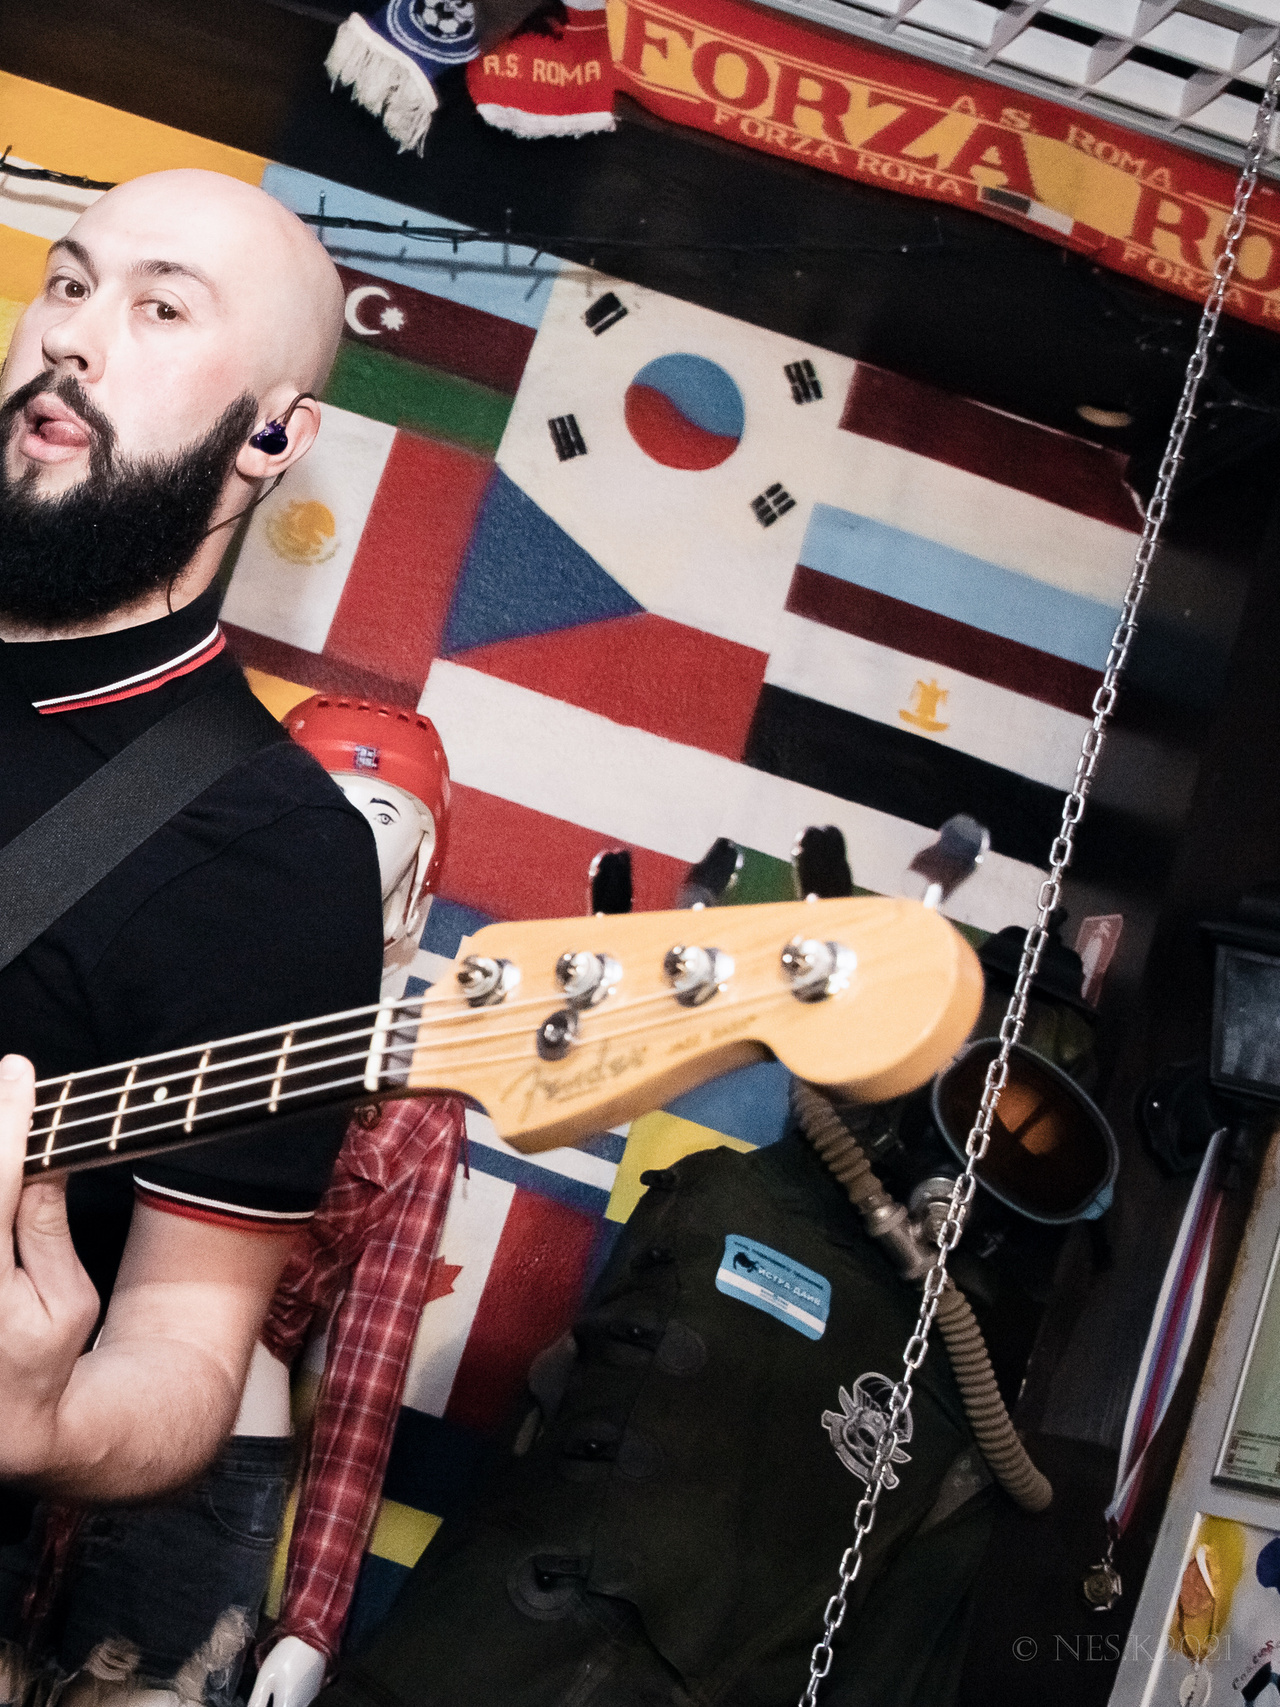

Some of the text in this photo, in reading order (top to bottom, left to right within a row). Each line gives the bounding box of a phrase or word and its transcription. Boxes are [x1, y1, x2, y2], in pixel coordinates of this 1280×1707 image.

[533, 58, 601, 87] ROMA
[622, 14, 1044, 203] FORZA
[713, 107, 963, 197] FORZA ROMA
[1067, 122, 1171, 190] ROMA
